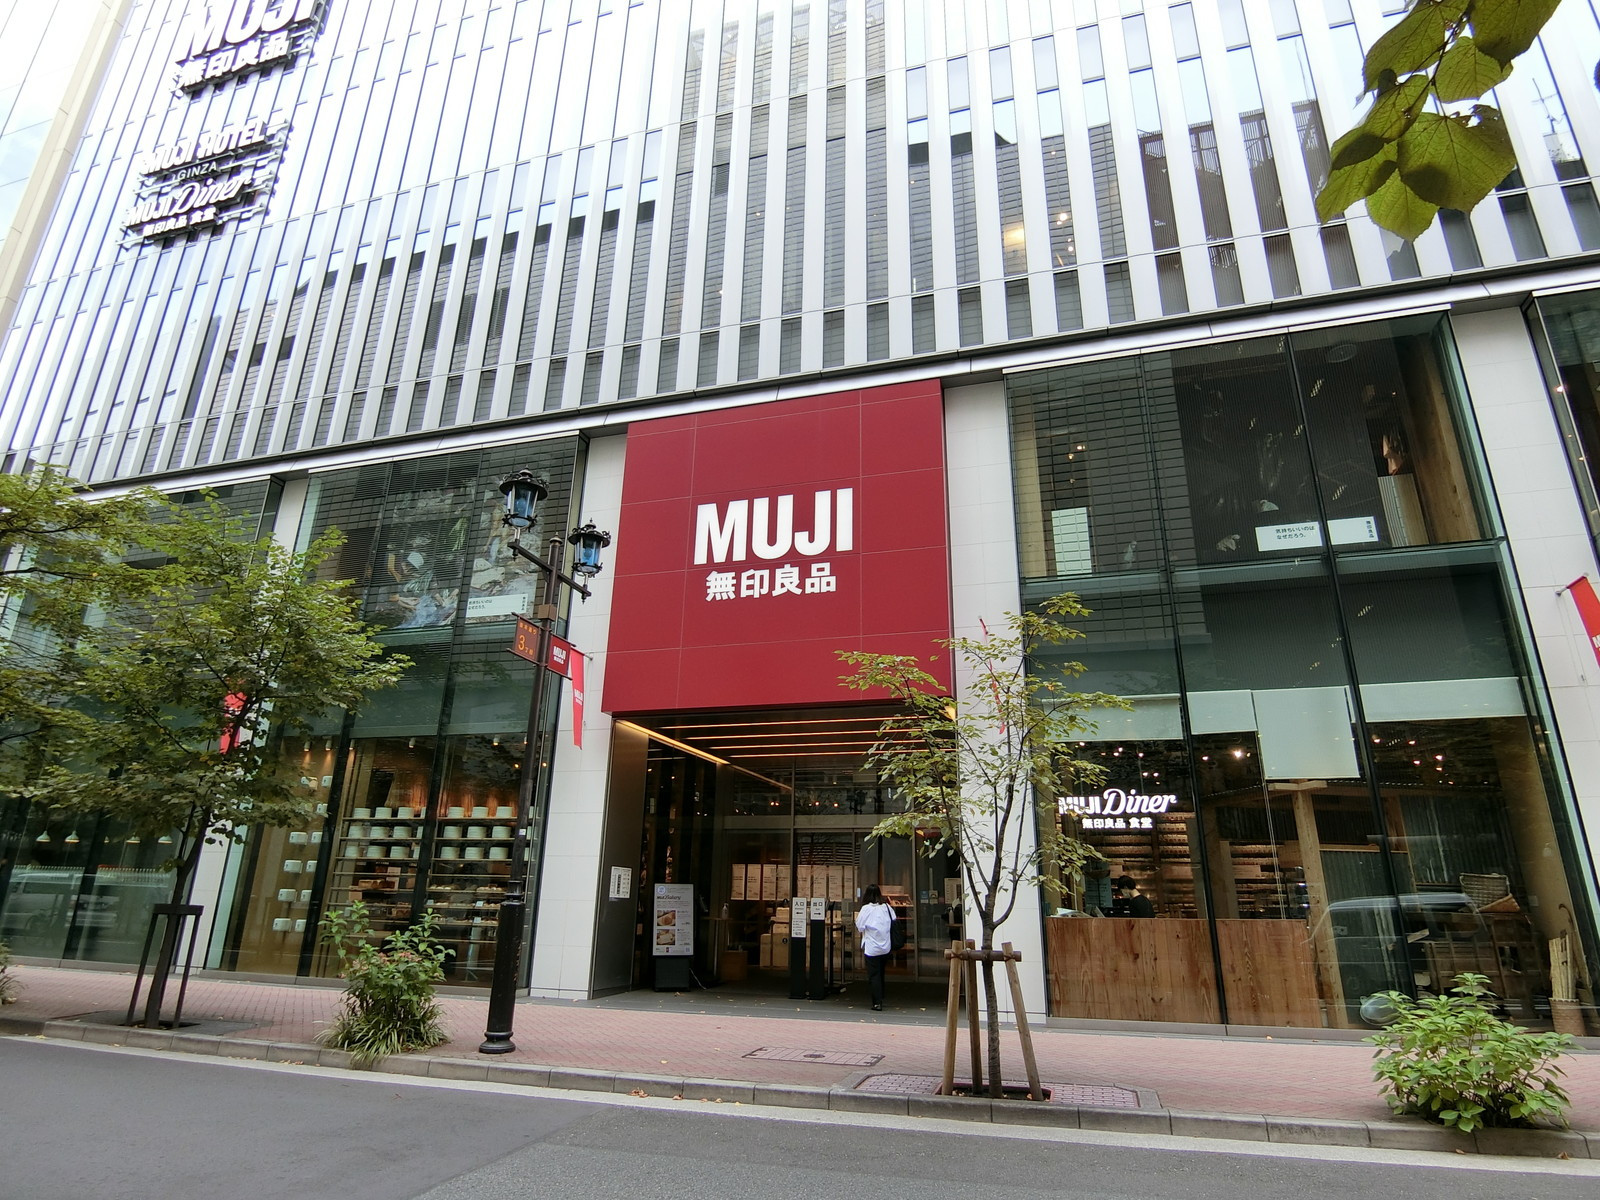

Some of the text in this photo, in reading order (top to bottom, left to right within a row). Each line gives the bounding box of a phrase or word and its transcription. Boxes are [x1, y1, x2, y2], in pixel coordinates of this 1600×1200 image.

[175, 30, 287, 88] 無印良品
[142, 120, 265, 175] MUJI HOTEL
[178, 161, 218, 180] GINZA
[126, 175, 252, 226] MUJI Diner
[693, 487, 853, 565] MUJI
[705, 562, 837, 602] 無印良品
[1058, 788, 1178, 815] MUJI Diner
[1082, 817, 1152, 829] 無印良品 食堂
